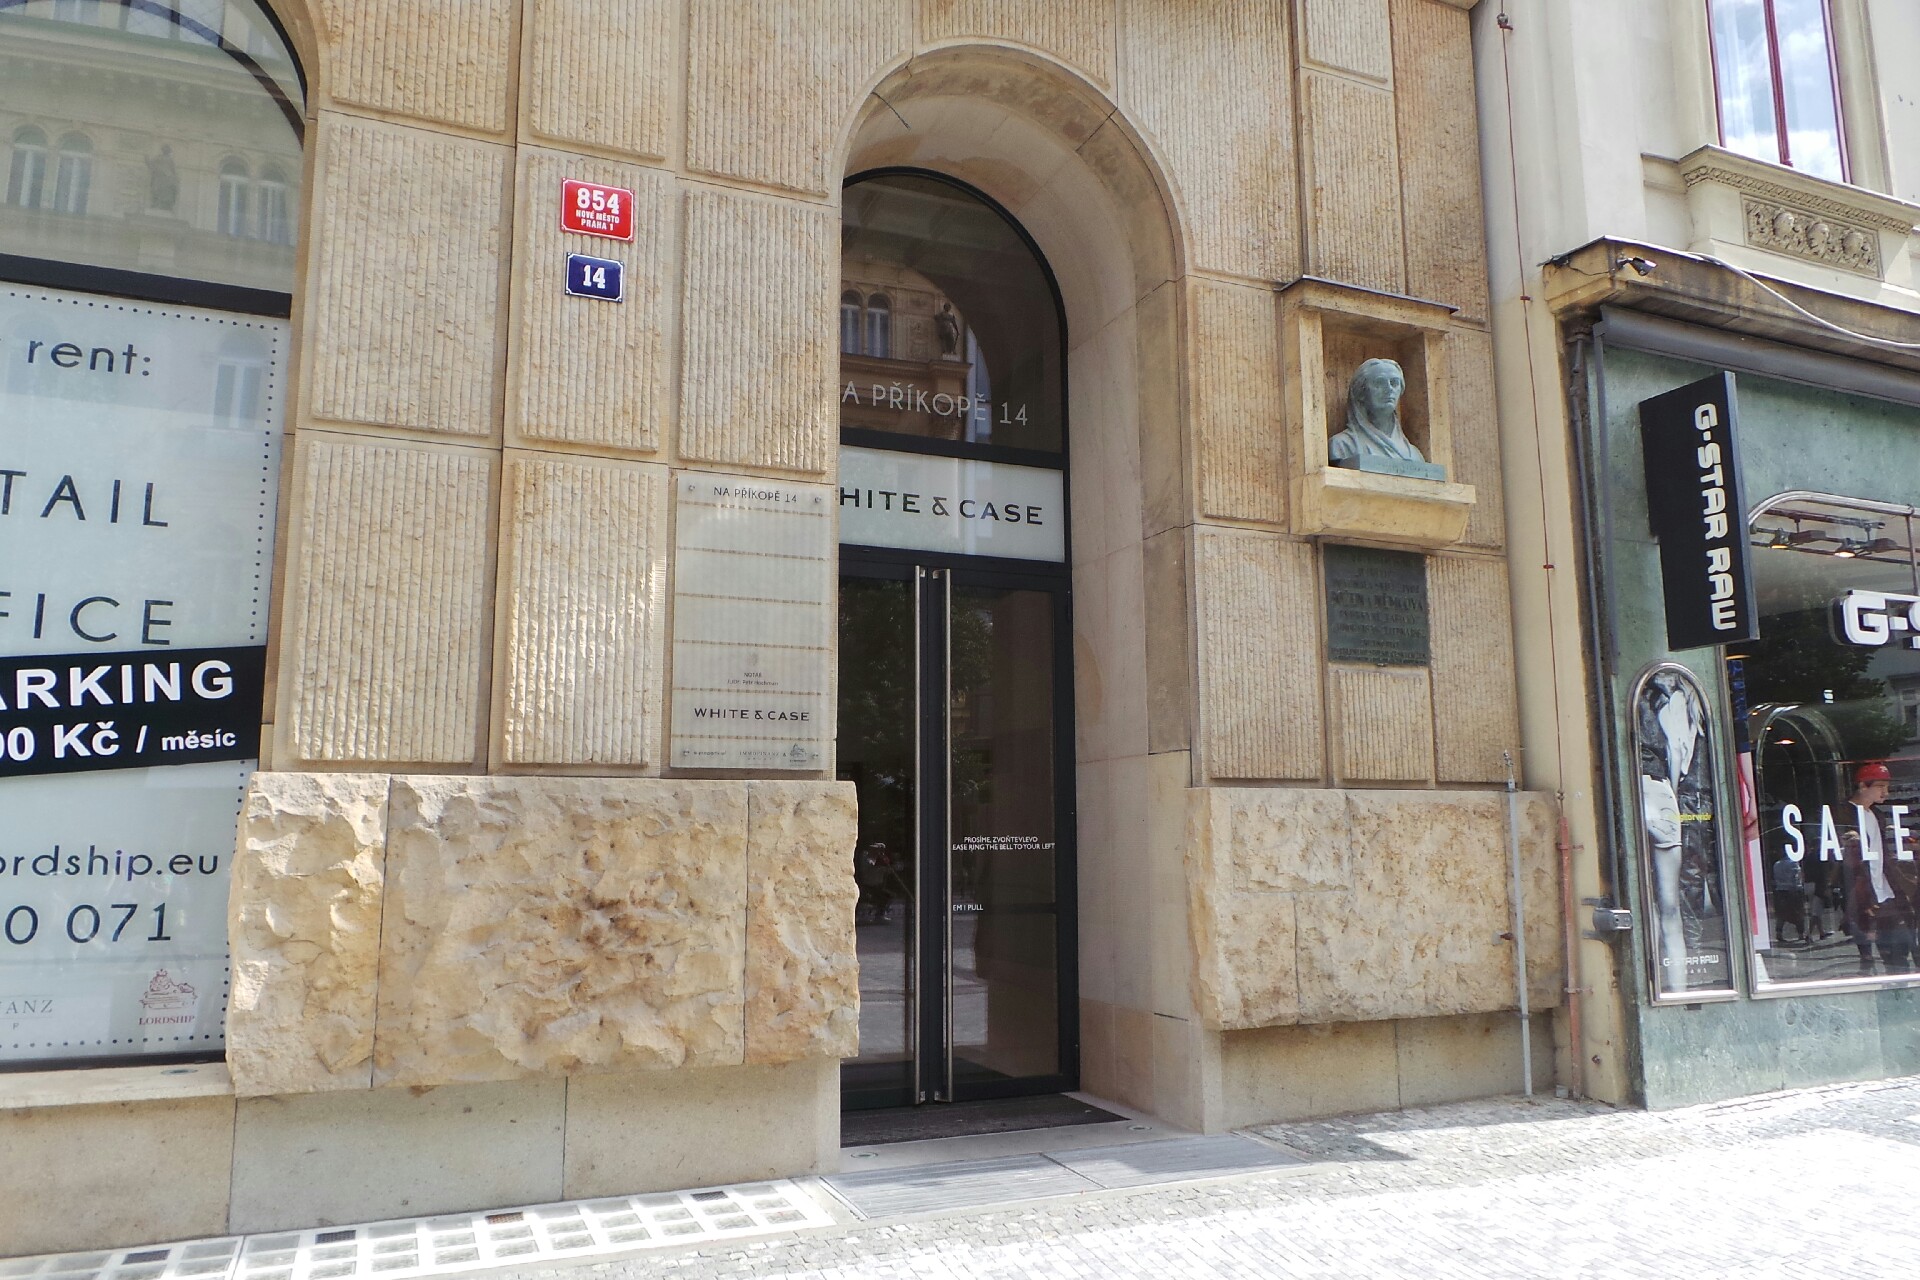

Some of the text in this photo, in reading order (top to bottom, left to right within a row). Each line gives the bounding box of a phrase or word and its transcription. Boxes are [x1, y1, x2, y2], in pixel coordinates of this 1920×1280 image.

[576, 209, 620, 224] NOVÉ MĚSTO
[577, 187, 619, 215] 854
[581, 218, 614, 231] PRAHA 1
[583, 265, 606, 289] 14
[27, 340, 151, 376] rent:
[872, 381, 987, 421] PŘÍKOPĚ
[1000, 402, 1028, 426] 14
[713, 487, 797, 503] NA PŘÍKOPĚ 14
[840, 486, 1043, 526] HITE & CASE
[1694, 403, 1737, 631] G-STAR RAW
[1843, 592, 1920, 650] G-
[0, 660, 233, 710] RKING
[694, 708, 809, 721] WHITE & CASE
[0, 721, 236, 761] 0 Kč / měsíc
[952, 843, 967, 851] EASE
[969, 843, 985, 851] RING
[1041, 842, 1055, 850] LEFT
[1782, 803, 1914, 862] SALE
[0, 845, 218, 881] rdship.eu
[5, 902, 171, 945] 0 071
[138, 1015, 195, 1026] LORDSHIP
